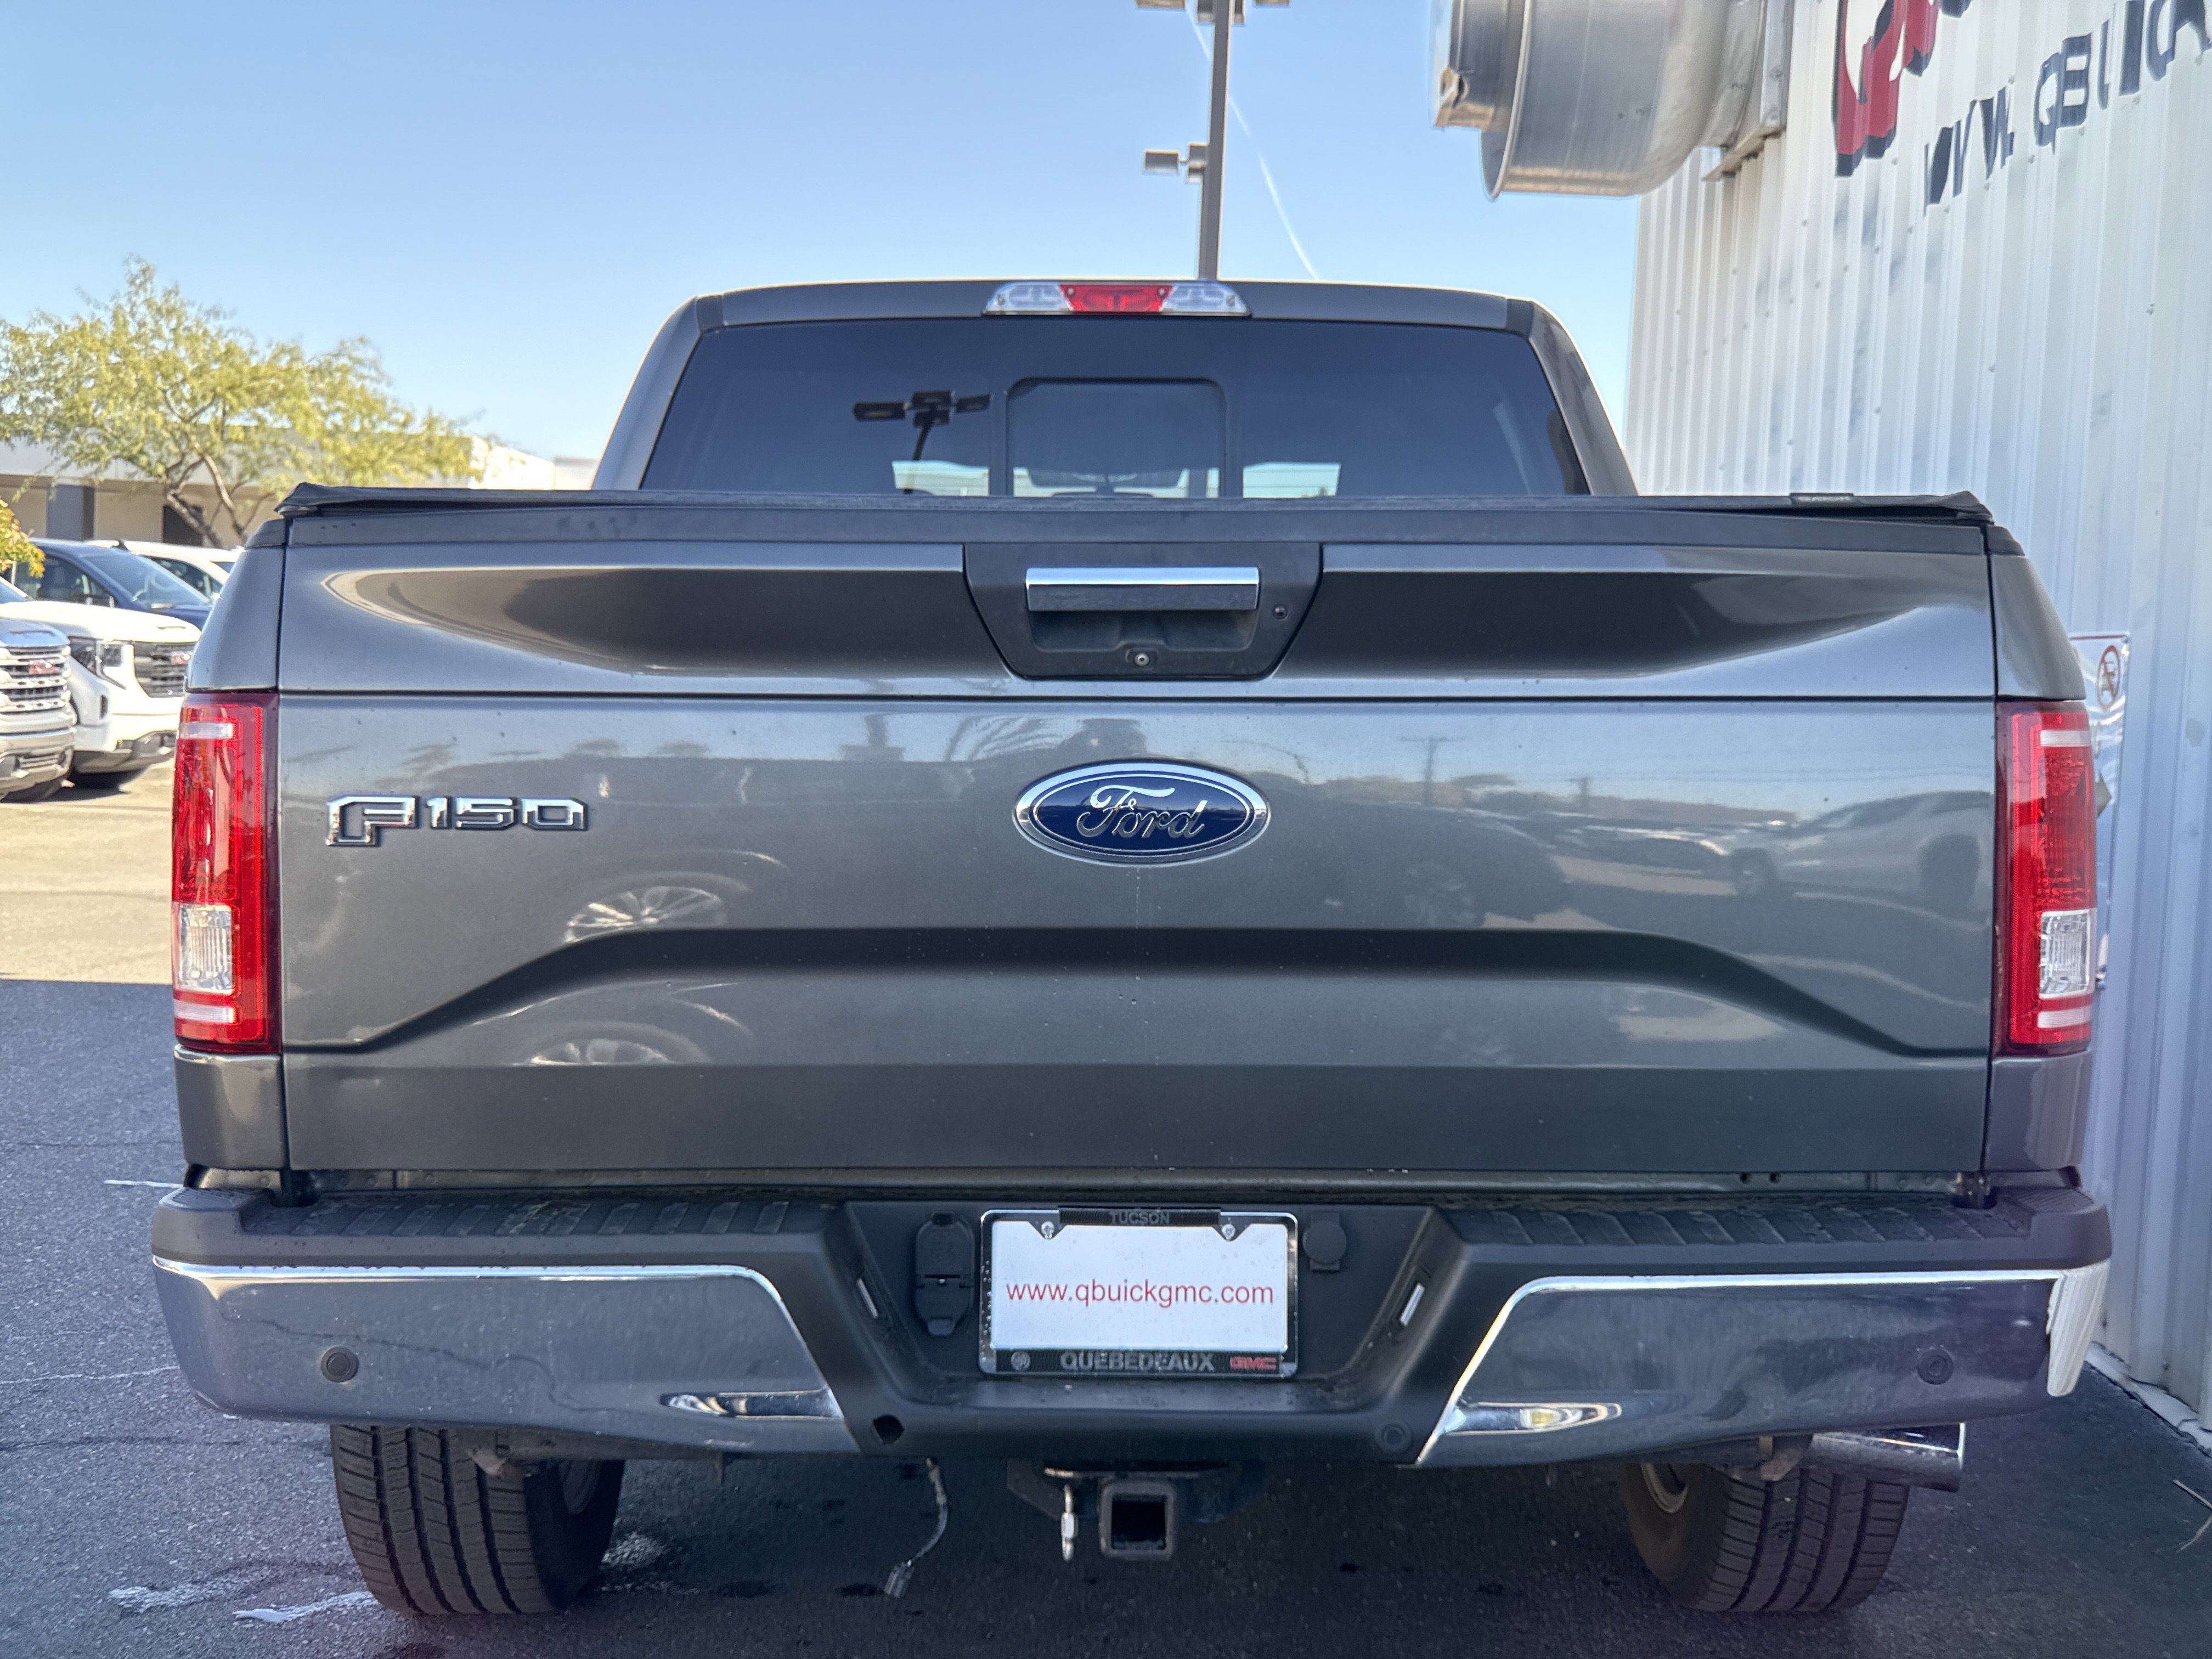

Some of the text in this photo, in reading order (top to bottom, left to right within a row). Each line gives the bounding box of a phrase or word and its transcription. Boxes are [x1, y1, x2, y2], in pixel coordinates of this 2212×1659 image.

[1076, 785, 1208, 839] Ford
[1109, 1210, 1170, 1225] TUCSON
[1006, 1279, 1274, 1308] www.qbuickgmc.com
[1060, 1351, 1277, 1371] QUEBEDEAUX GMC
